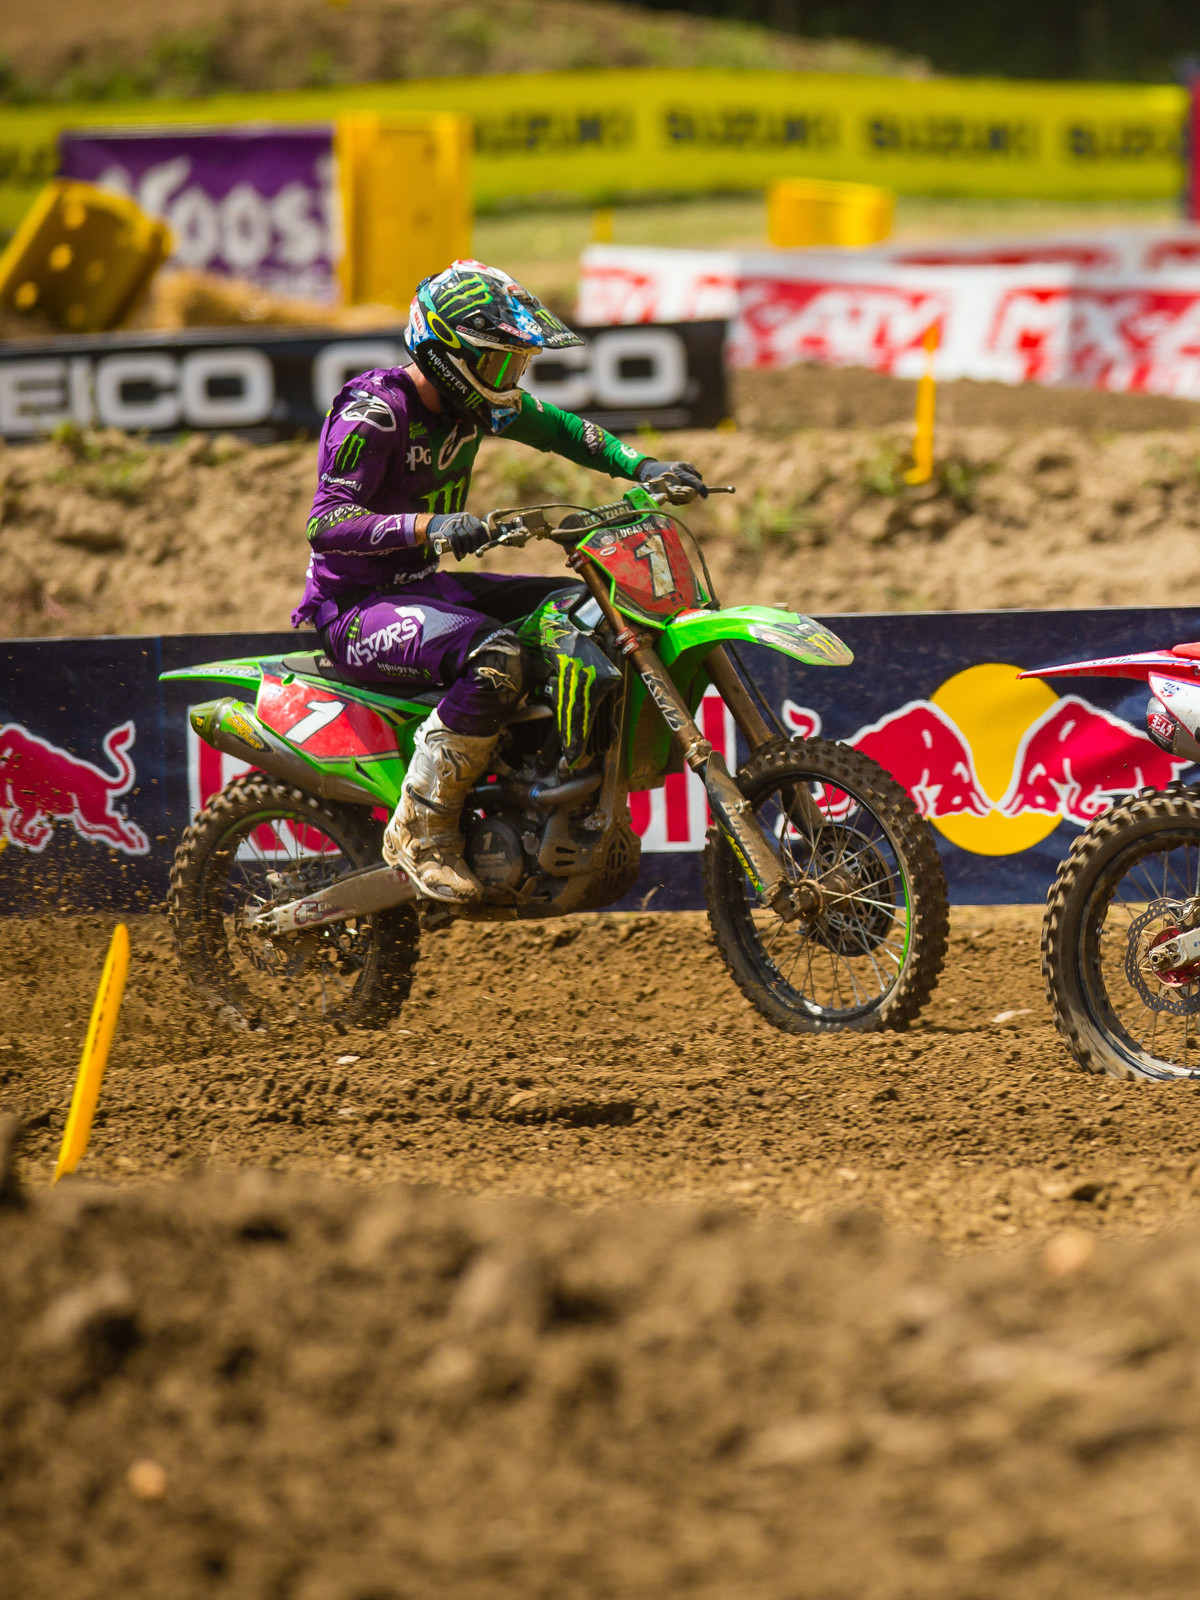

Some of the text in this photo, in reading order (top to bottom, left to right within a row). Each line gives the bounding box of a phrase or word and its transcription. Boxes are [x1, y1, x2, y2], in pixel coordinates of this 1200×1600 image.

[427, 348, 468, 395] MONSTER
[633, 532, 677, 600] 1
[284, 699, 348, 744] 1
